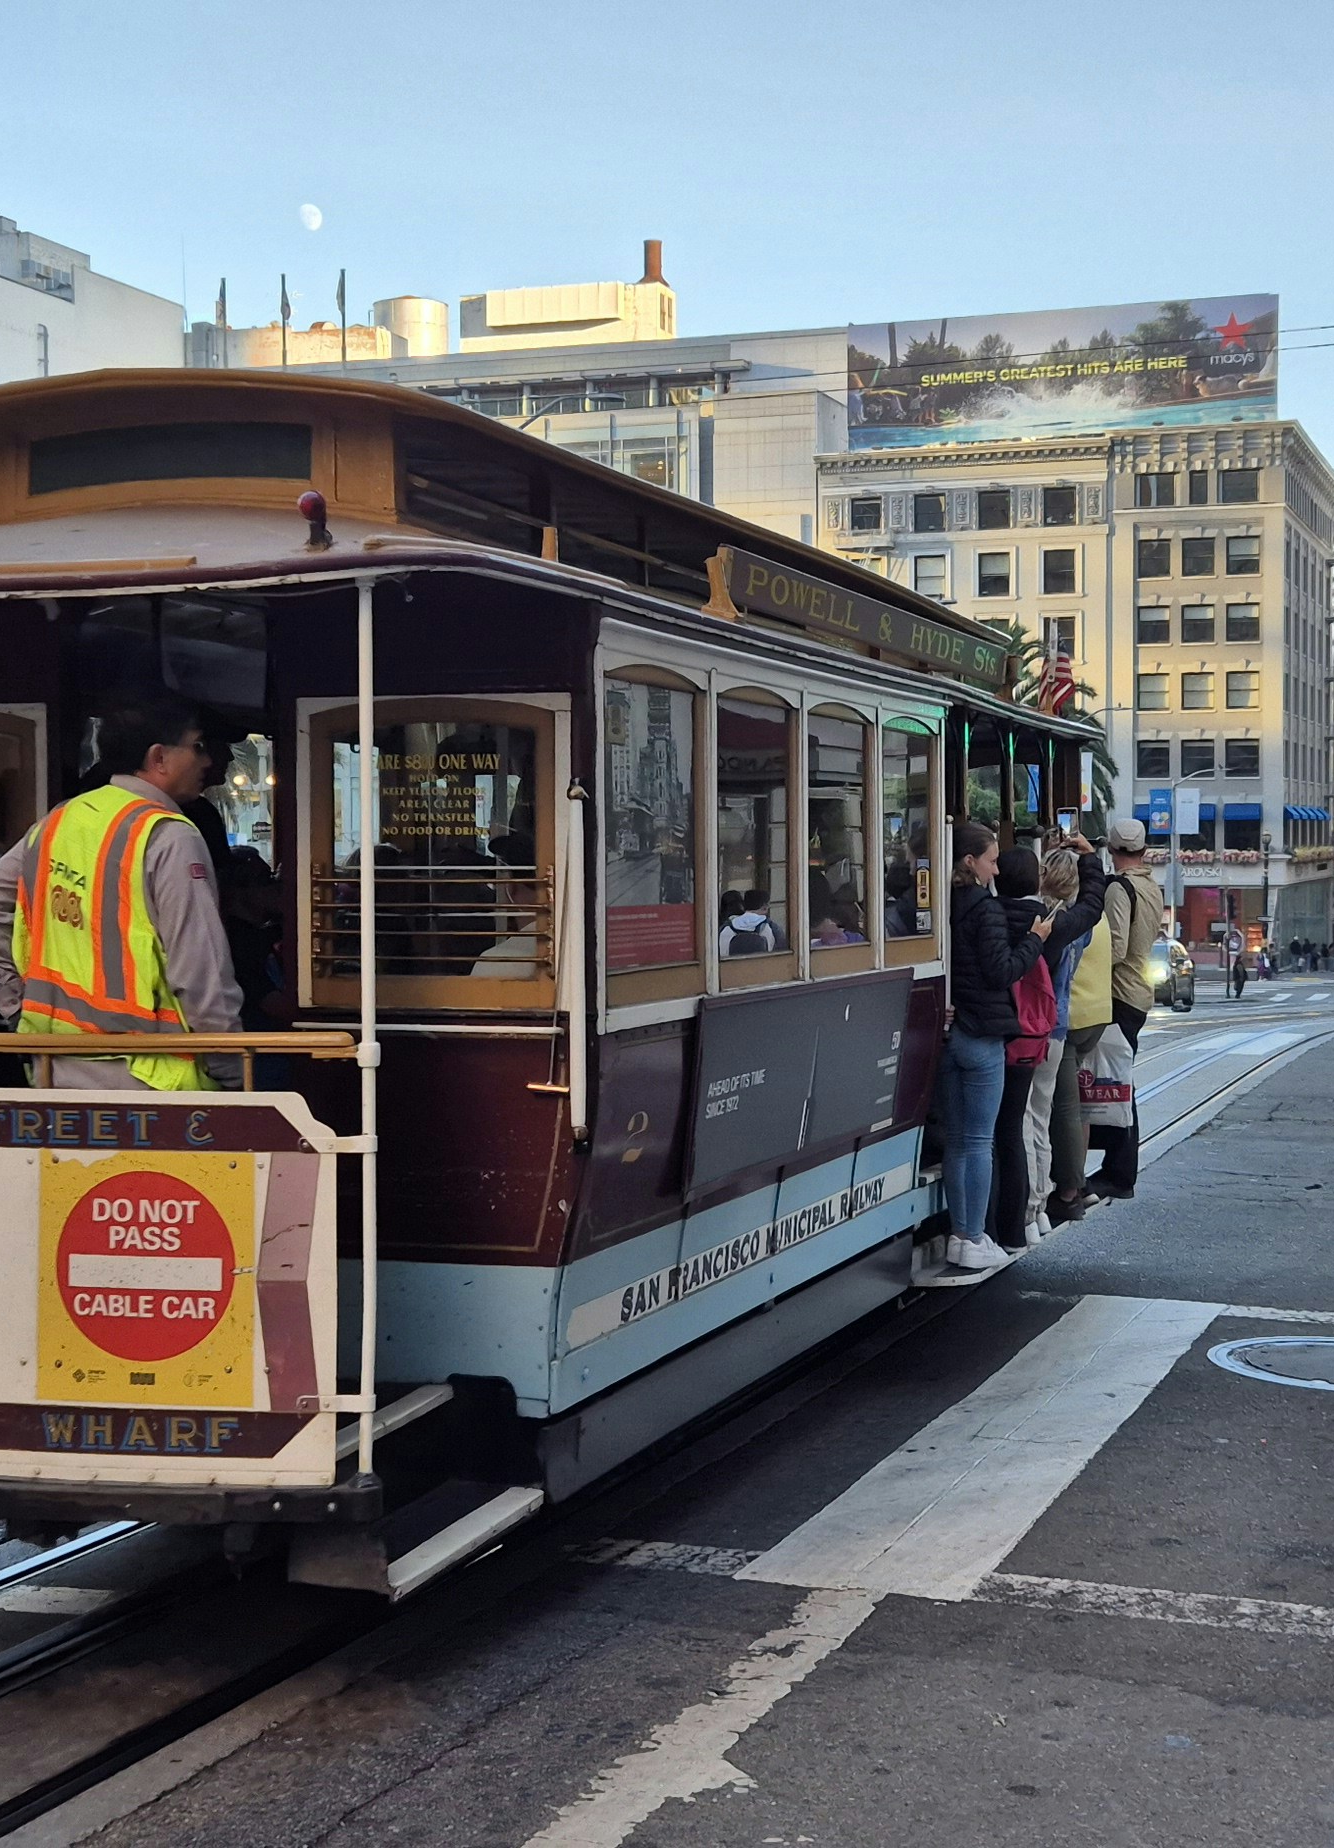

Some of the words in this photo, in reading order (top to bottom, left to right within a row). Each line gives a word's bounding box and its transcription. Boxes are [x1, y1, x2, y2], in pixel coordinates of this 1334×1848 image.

[1210, 352, 1255, 366] macy's
[921, 371, 996, 388] SUMMER'S
[1000, 364, 1073, 381] GREATEST
[1077, 362, 1110, 376] HITS
[1114, 360, 1144, 373] ARE
[1147, 356, 1188, 370] HERE
[745, 564, 860, 632] POWELL
[878, 612, 893, 643] &
[910, 623, 965, 665] HYDE
[973, 646, 998, 676] Sts.
[438, 753, 468, 770] ONE
[471, 753, 501, 770] WAY
[398, 800, 429, 809] AREA
[433, 799, 470, 809] CLEAR
[392, 812, 409, 822] NO
[382, 826, 399, 835] NO
[402, 826, 432, 835] FOOD
[435, 826, 452, 836] OR
[1180, 867, 1224, 877] AROVSKI
[707, 1078, 730, 1098] AHEAD
[730, 1075, 740, 1091] OF
[1084, 1088, 1121, 1099] WEAR
[621, 1111, 649, 1164] 2
[92, 1198, 134, 1223] DO
[138, 1199, 201, 1224] NOT
[108, 1225, 182, 1252] PASS
[620, 1274, 661, 1323] SAN
[667, 1229, 760, 1301] FRANCISCO
[765, 1199, 836, 1255] MUNICIPAL
[73, 1292, 155, 1318] CABLE
[161, 1295, 216, 1320] CAR
[41, 1411, 239, 1453] WHARF
